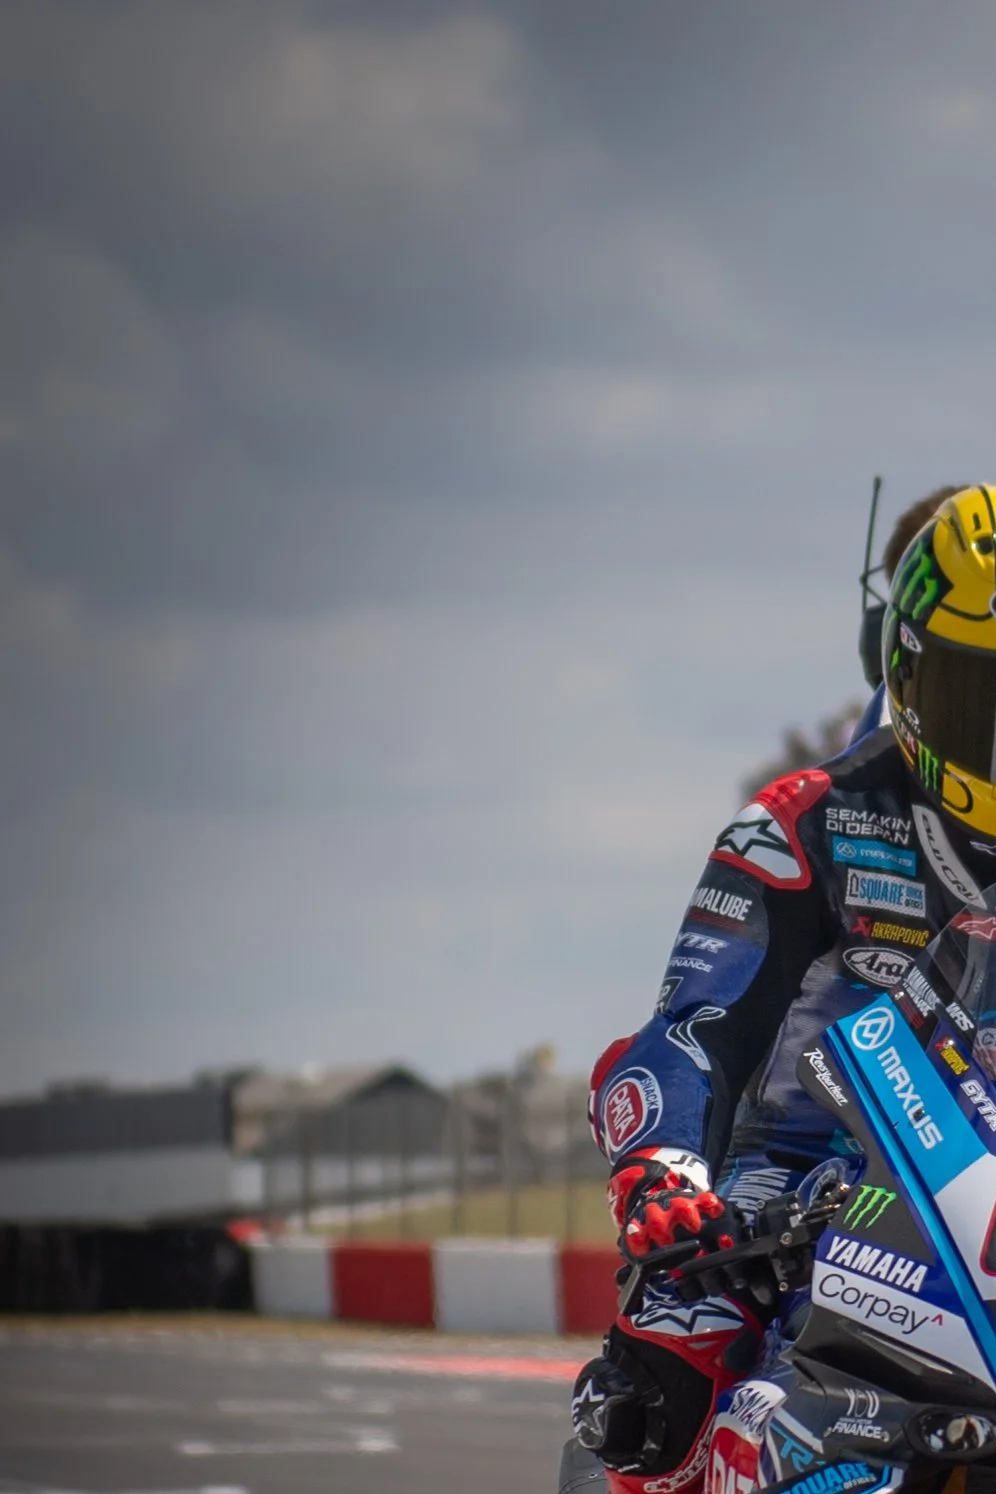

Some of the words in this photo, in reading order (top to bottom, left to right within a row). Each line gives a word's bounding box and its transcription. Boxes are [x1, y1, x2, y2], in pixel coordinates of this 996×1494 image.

[609, 1085, 636, 1141] PATA
[877, 1046, 944, 1149] MAXUS
[825, 1236, 929, 1293] YAMAHA
